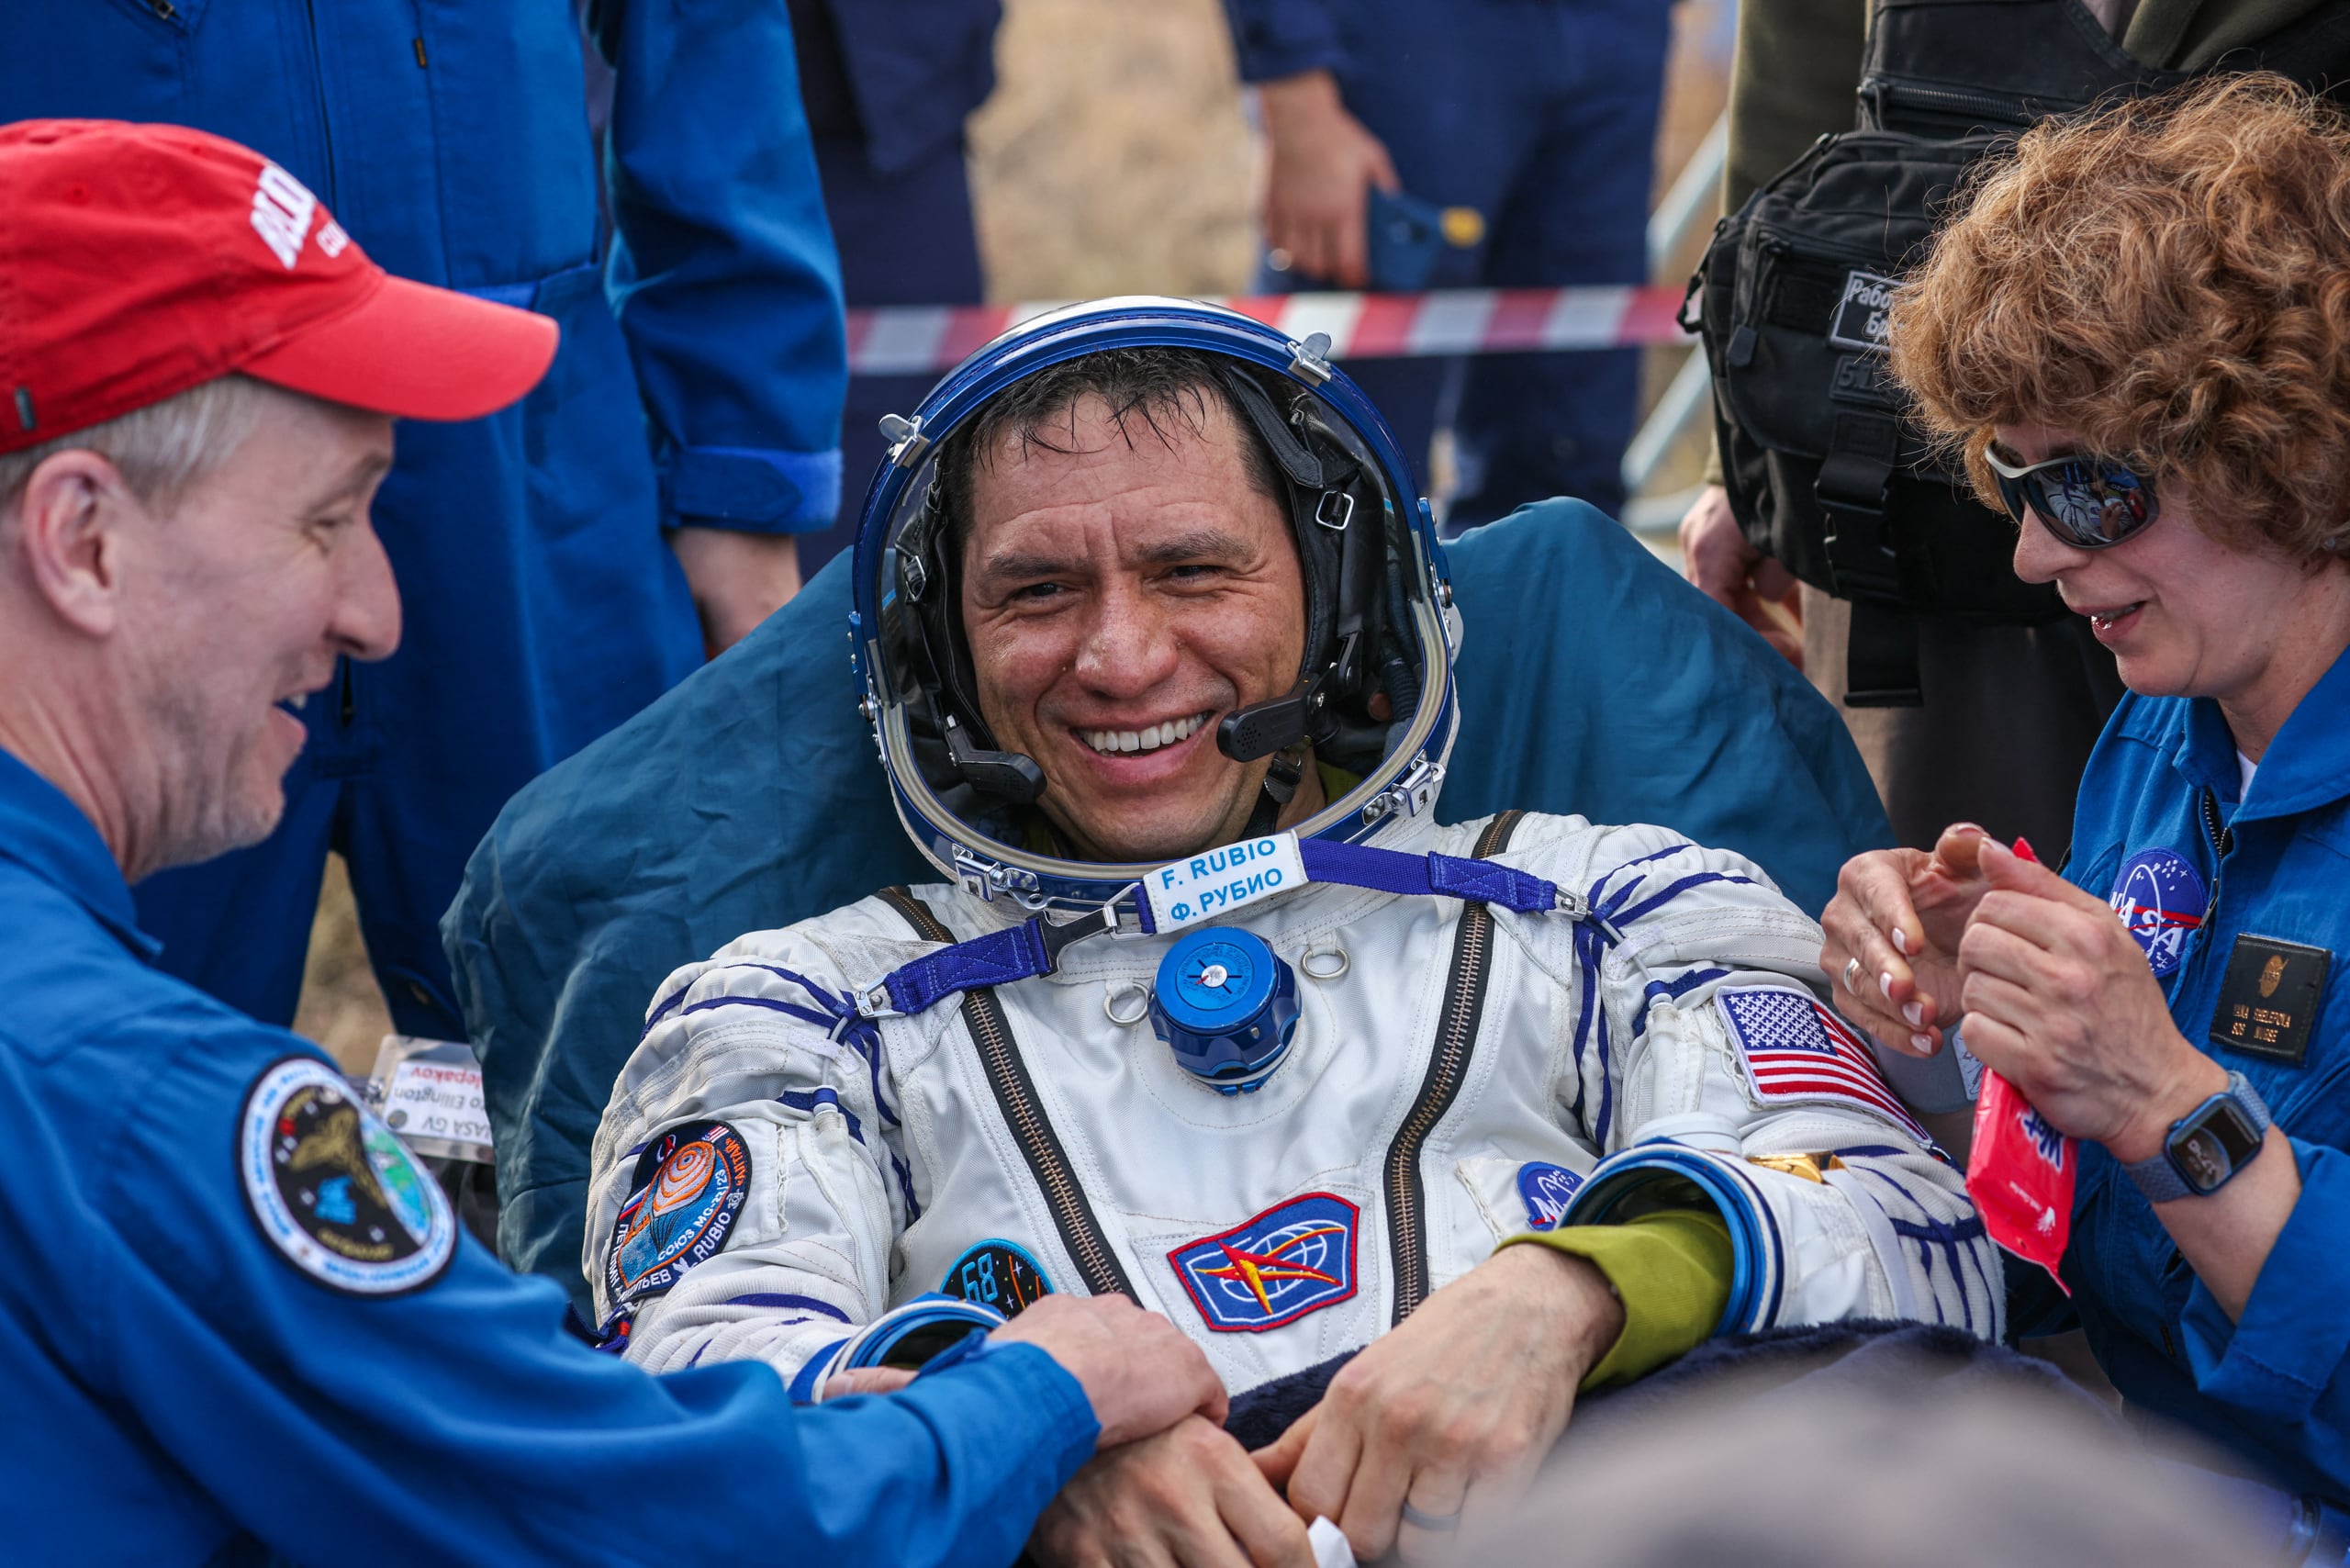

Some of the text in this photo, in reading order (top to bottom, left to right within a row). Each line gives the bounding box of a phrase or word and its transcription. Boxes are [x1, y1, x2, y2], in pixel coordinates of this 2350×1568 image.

[1846, 278, 1892, 310] Рабо
[1161, 839, 1276, 890] F. RUBIO
[394, 1086, 465, 1110] Ellington
[692, 1212, 732, 1261] RUBIO
[961, 1252, 999, 1303] 68
